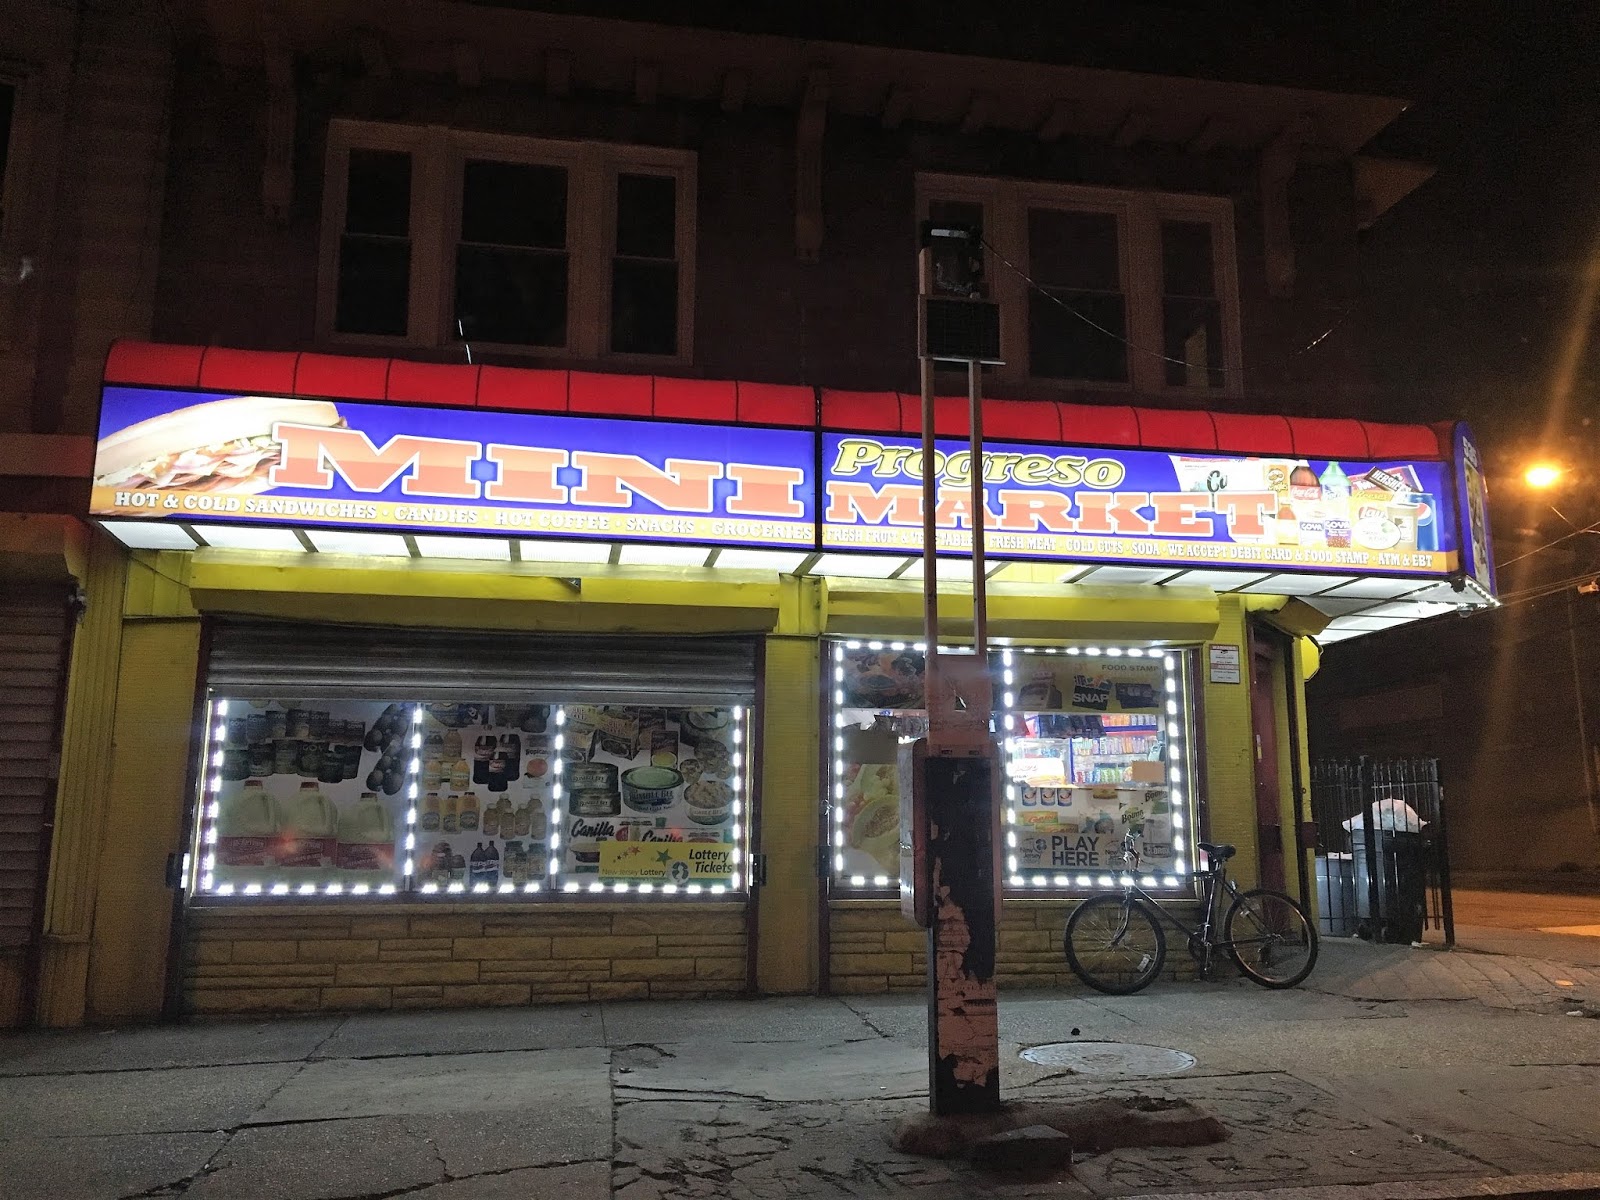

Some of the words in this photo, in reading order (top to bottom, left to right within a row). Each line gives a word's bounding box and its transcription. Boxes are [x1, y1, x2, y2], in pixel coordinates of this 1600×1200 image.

[269, 421, 804, 518] MINI
[831, 438, 1126, 489] Progreso
[115, 491, 160, 507] HOT
[163, 493, 178, 509] &
[184, 494, 240, 512] COLD
[245, 499, 377, 519] SANDWICHES
[394, 505, 478, 523] CANDIES
[494, 511, 533, 527] HOT
[538, 514, 610, 530] COFFEE
[625, 517, 695, 534] SNACKS
[711, 521, 813, 540] GROCERIES
[826, 480, 1278, 540] MARKET
[826, 527, 863, 542] FRESH
[866, 529, 897, 543] FRUIT
[988, 535, 1024, 549] FRESH
[1027, 537, 1056, 551] MEAT
[1066, 538, 1093, 552] COLD
[1099, 541, 1123, 554] CUTS
[1132, 543, 1160, 556] SODA
[1168, 543, 1185, 556] WE
[1187, 544, 1227, 559] ACCEPT
[1231, 546, 1261, 560] DEBIT
[1264, 547, 1292, 561] CARD
[1304, 549, 1332, 563] FOOD
[1336, 551, 1370, 564] STAMP
[1378, 552, 1399, 566] ATM
[1402, 554, 1411, 566] &
[1412, 555, 1433, 567] EBT
[1130, 664, 1159, 672] STAMP
[1073, 692, 1109, 703] SNAP
[571, 818, 615, 838] Canilla
[1051, 835, 1100, 850] PLAY
[689, 848, 729, 863] Lottery
[1052, 851, 1100, 867] HERE
[640, 868, 667, 877] Lottery
[695, 861, 733, 873] Tickets
